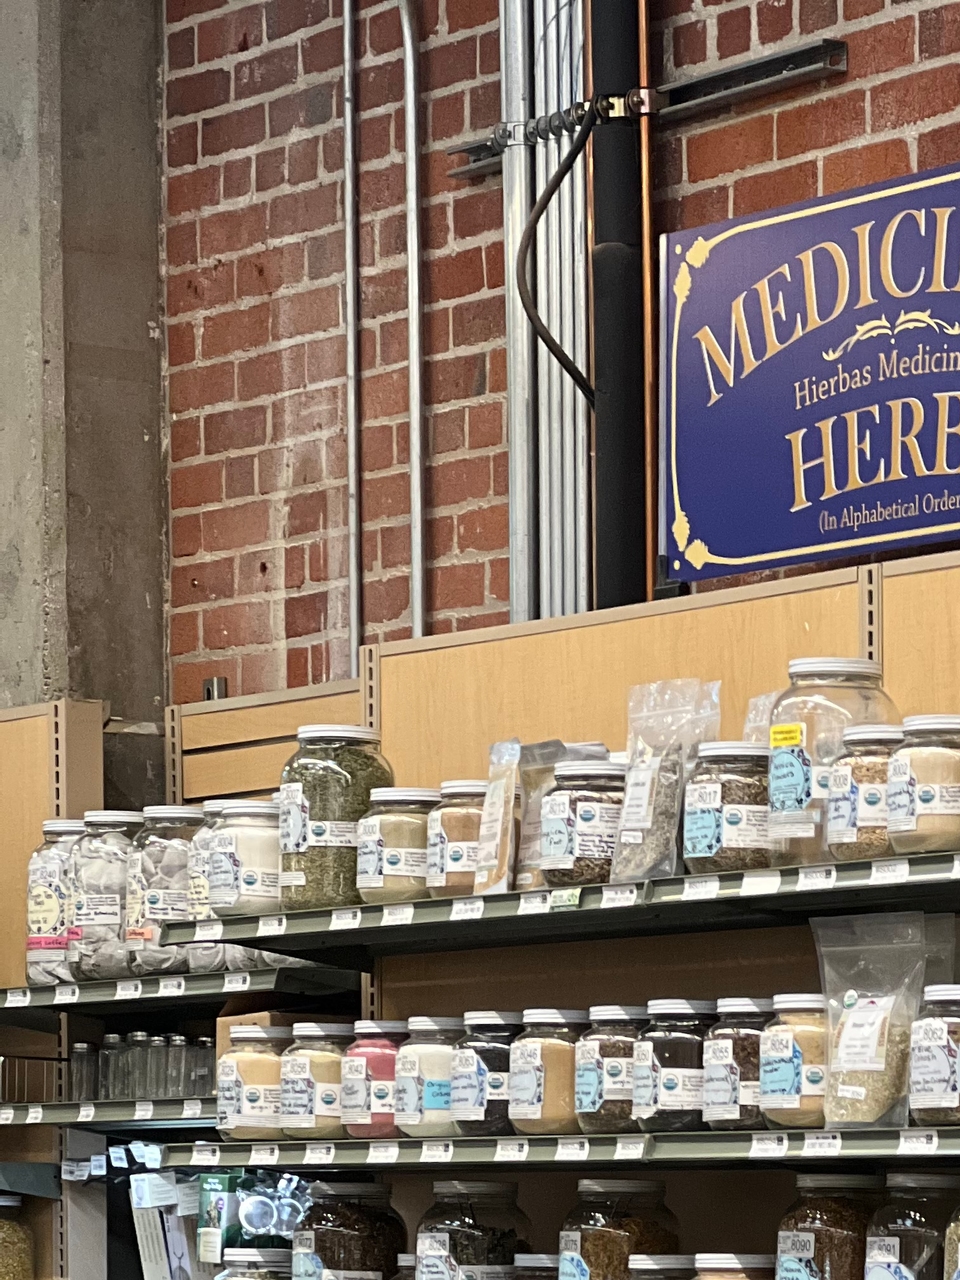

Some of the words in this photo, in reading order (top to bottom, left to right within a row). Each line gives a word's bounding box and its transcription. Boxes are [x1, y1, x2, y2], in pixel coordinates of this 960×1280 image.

[795, 362, 872, 410] Hierbas
[820, 506, 838, 532] (In
[841, 494, 919, 532] Alphabetical
[790, 1238, 811, 1252] 8090
